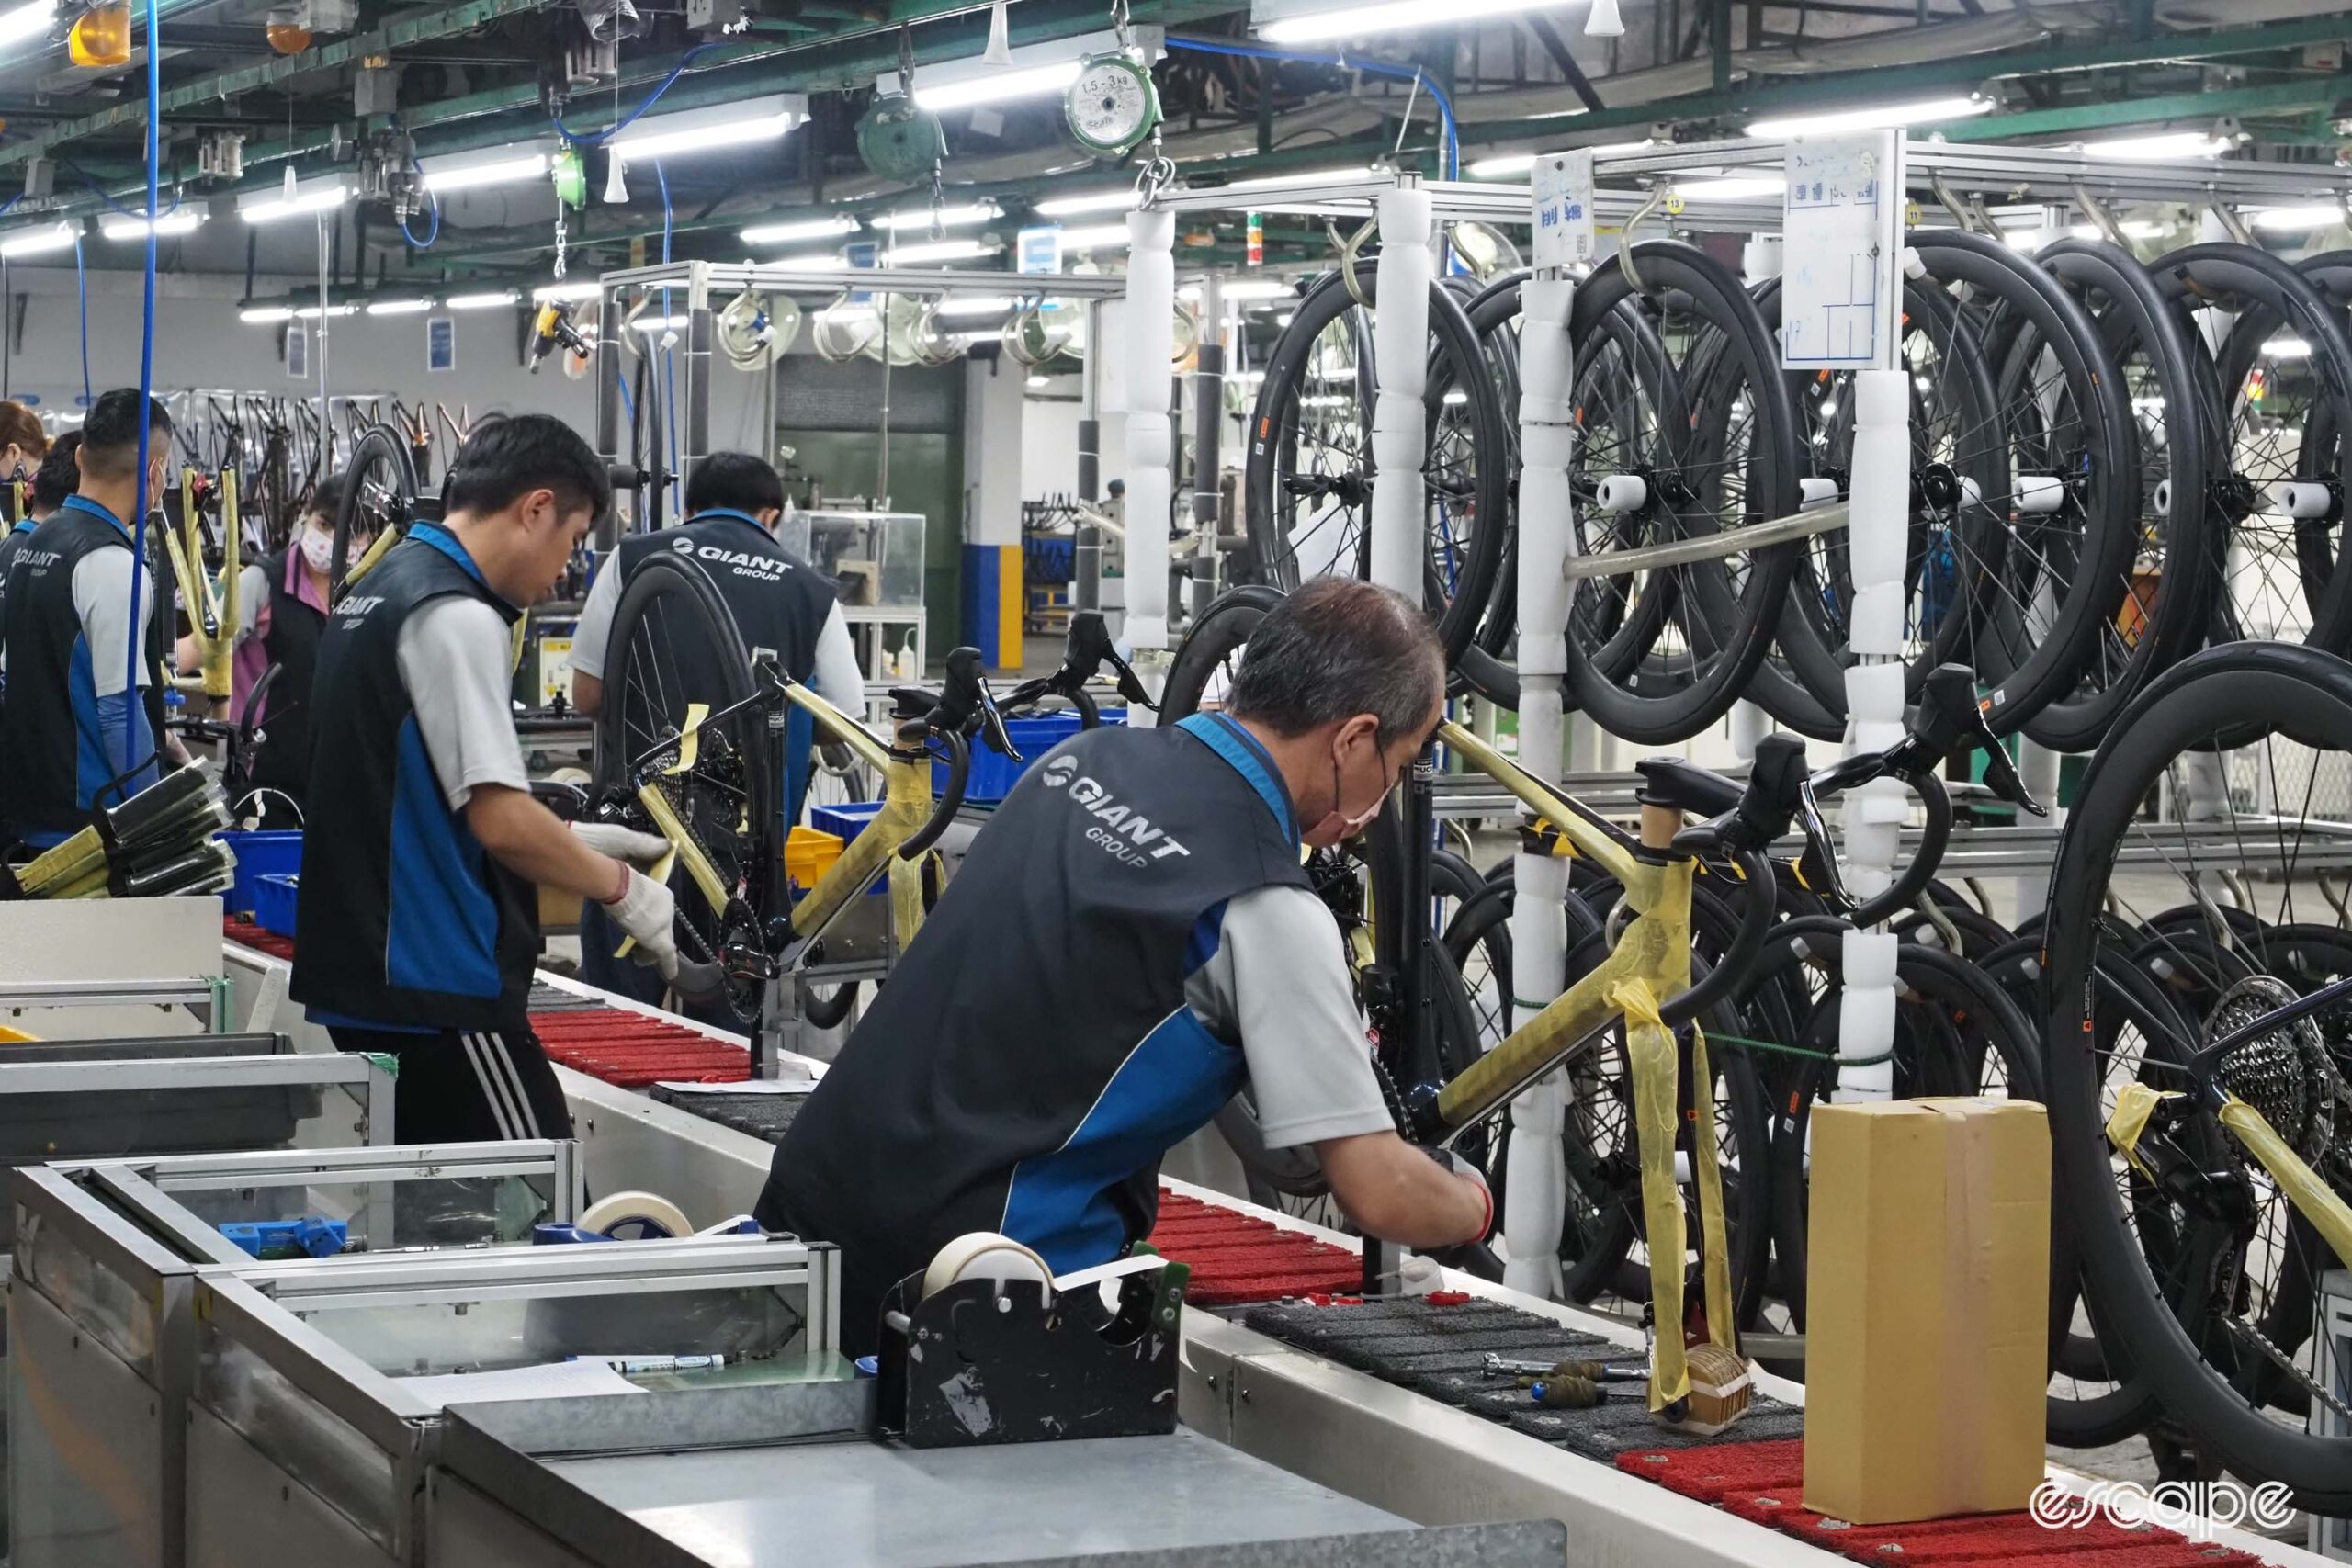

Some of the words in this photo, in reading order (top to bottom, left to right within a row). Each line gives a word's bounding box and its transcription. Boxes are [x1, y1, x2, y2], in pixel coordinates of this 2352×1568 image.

[1082, 80, 1098, 94] 1.5
[1909, 211, 1918, 220] 11
[17, 548, 62, 567] GIANT
[698, 546, 793, 574] GIANT
[732, 567, 781, 581] GROUP
[1069, 776, 1191, 859] GIANT
[1085, 827, 1148, 868] GROUP
